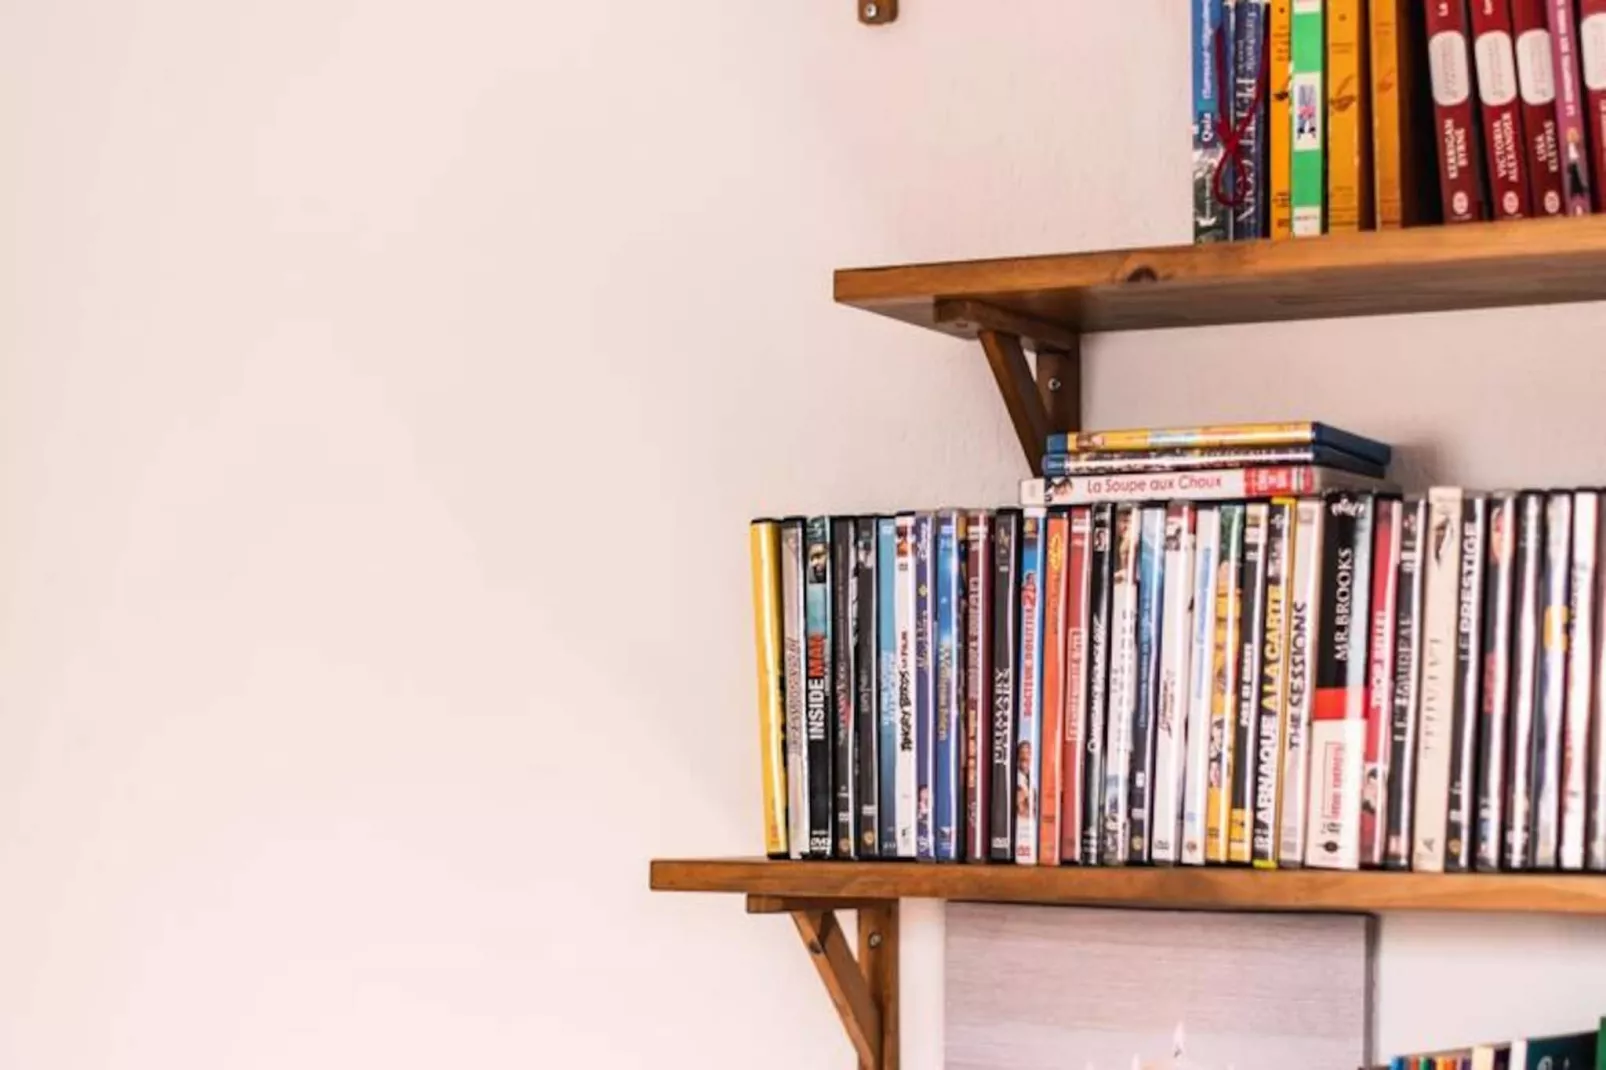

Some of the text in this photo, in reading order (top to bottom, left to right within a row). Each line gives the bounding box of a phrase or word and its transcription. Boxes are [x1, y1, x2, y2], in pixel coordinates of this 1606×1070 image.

[1444, 119, 1458, 179] KERRIGAN
[1456, 128, 1468, 167] BYRNE
[1492, 120, 1506, 178] VICTORIA
[1503, 112, 1518, 182] ALEXANDER
[1535, 134, 1547, 161] LISA
[1544, 120, 1558, 172] KLEYPAS
[1087, 475, 1222, 494] La Soupe aux Choux
[1335, 547, 1353, 626] BROOKS
[1459, 522, 1477, 661] LE PRESTIGE
[1264, 585, 1281, 661] CARTE
[808, 634, 824, 740] INSIDE MAN
[899, 670, 911, 709] BIRDS
[1023, 663, 1033, 717] DOCTEUR
[1288, 600, 1307, 750] THE SESSIONS
[900, 710, 912, 752] ANGRY
[994, 666, 1003, 765] PRIMARY
[1257, 714, 1278, 824] ARNAQUE
